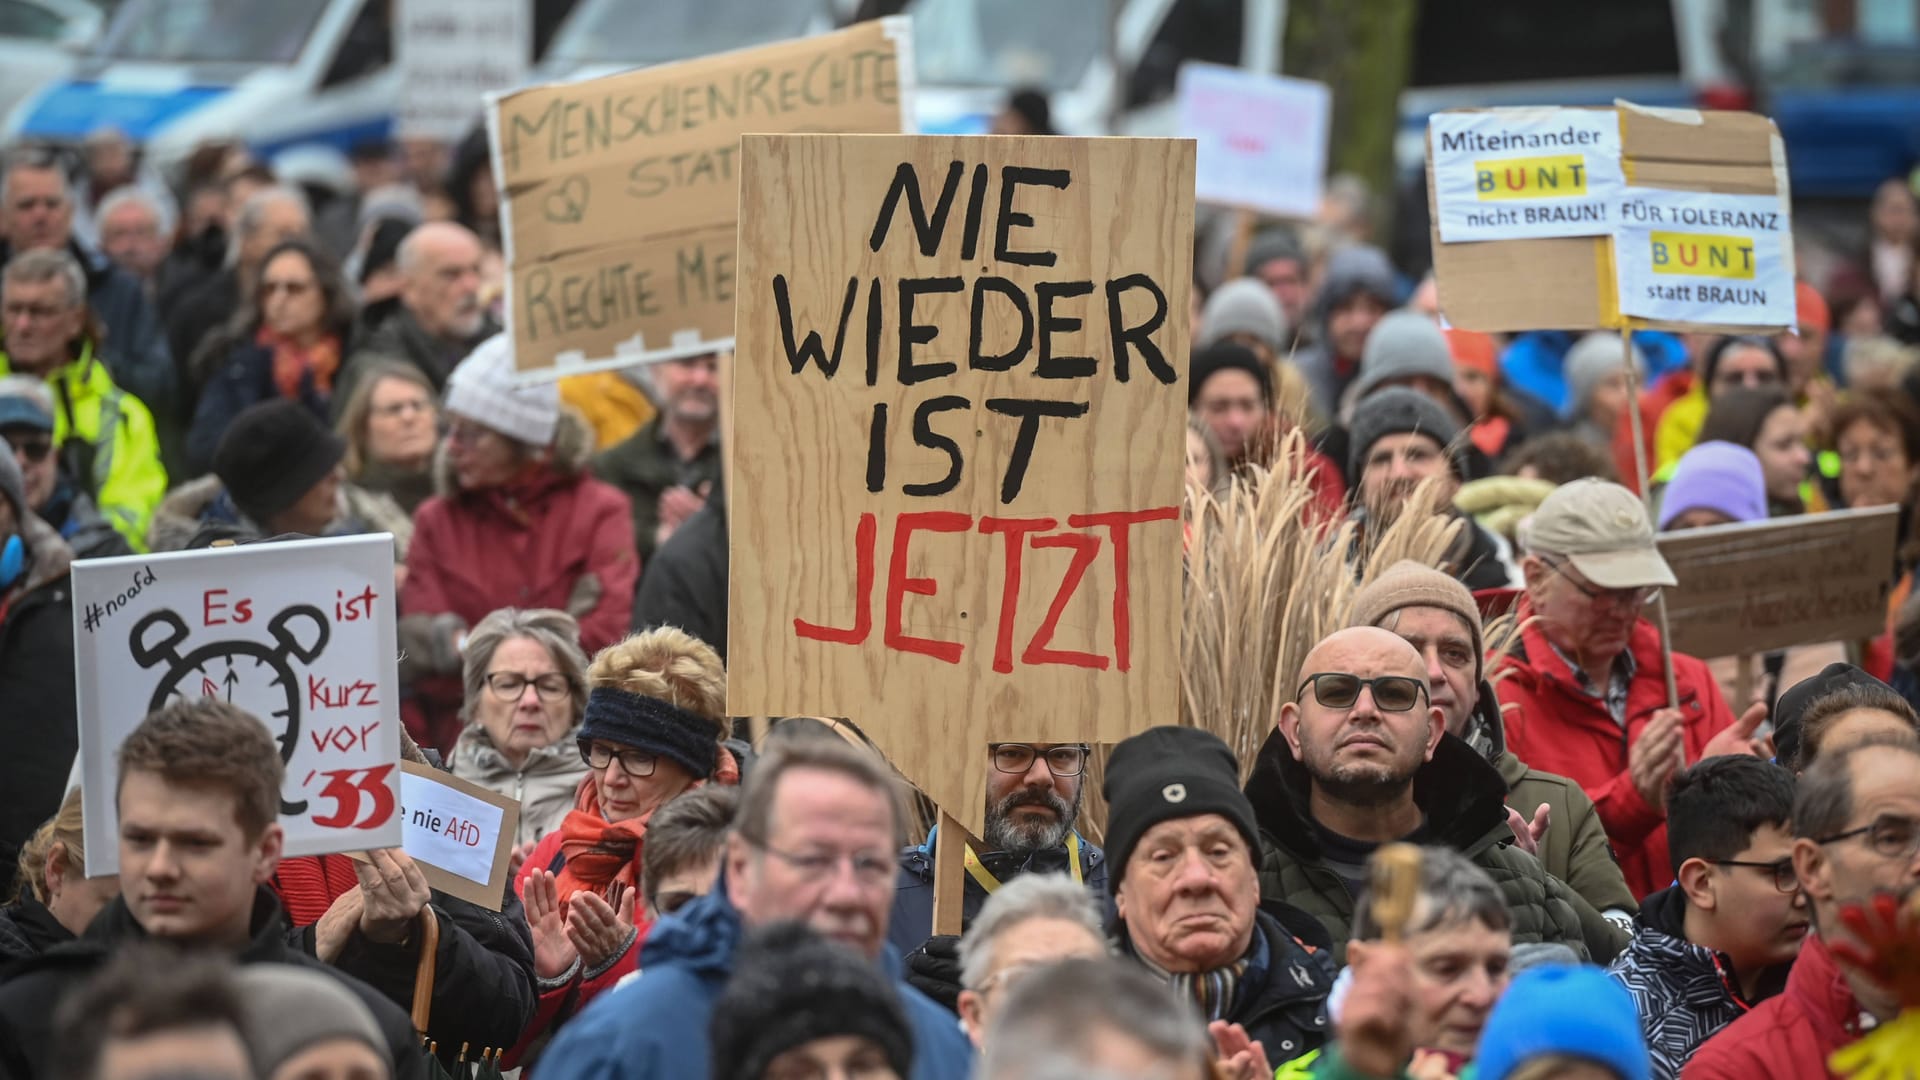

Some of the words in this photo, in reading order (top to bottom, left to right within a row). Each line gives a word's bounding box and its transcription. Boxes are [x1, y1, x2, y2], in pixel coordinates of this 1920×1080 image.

[510, 49, 899, 172] MENSCHENRECHTE
[1440, 126, 1601, 153] Miteinander
[1476, 165, 1585, 193] BUNT
[869, 161, 1070, 268] NIE
[1467, 205, 1518, 228] nicht
[1525, 203, 1607, 225] BRAUN!
[1621, 202, 1664, 224] FÜR
[1671, 206, 1780, 232] TOLERANZ
[1651, 242, 1754, 271] BUNT
[524, 260, 664, 342] RECHTE
[1646, 284, 1691, 301] statt
[1697, 285, 1767, 306] BRAUN
[772, 273, 1178, 386] WIEDER
[866, 394, 1090, 505] IST
[83, 566, 157, 633] #noafd
[203, 589, 253, 626] Es
[335, 585, 378, 622] ist
[793, 506, 1180, 674] JETZT
[311, 721, 380, 753] vor
[302, 763, 396, 830] '33
[412, 808, 442, 833] nie
[443, 816, 481, 848] AfD
